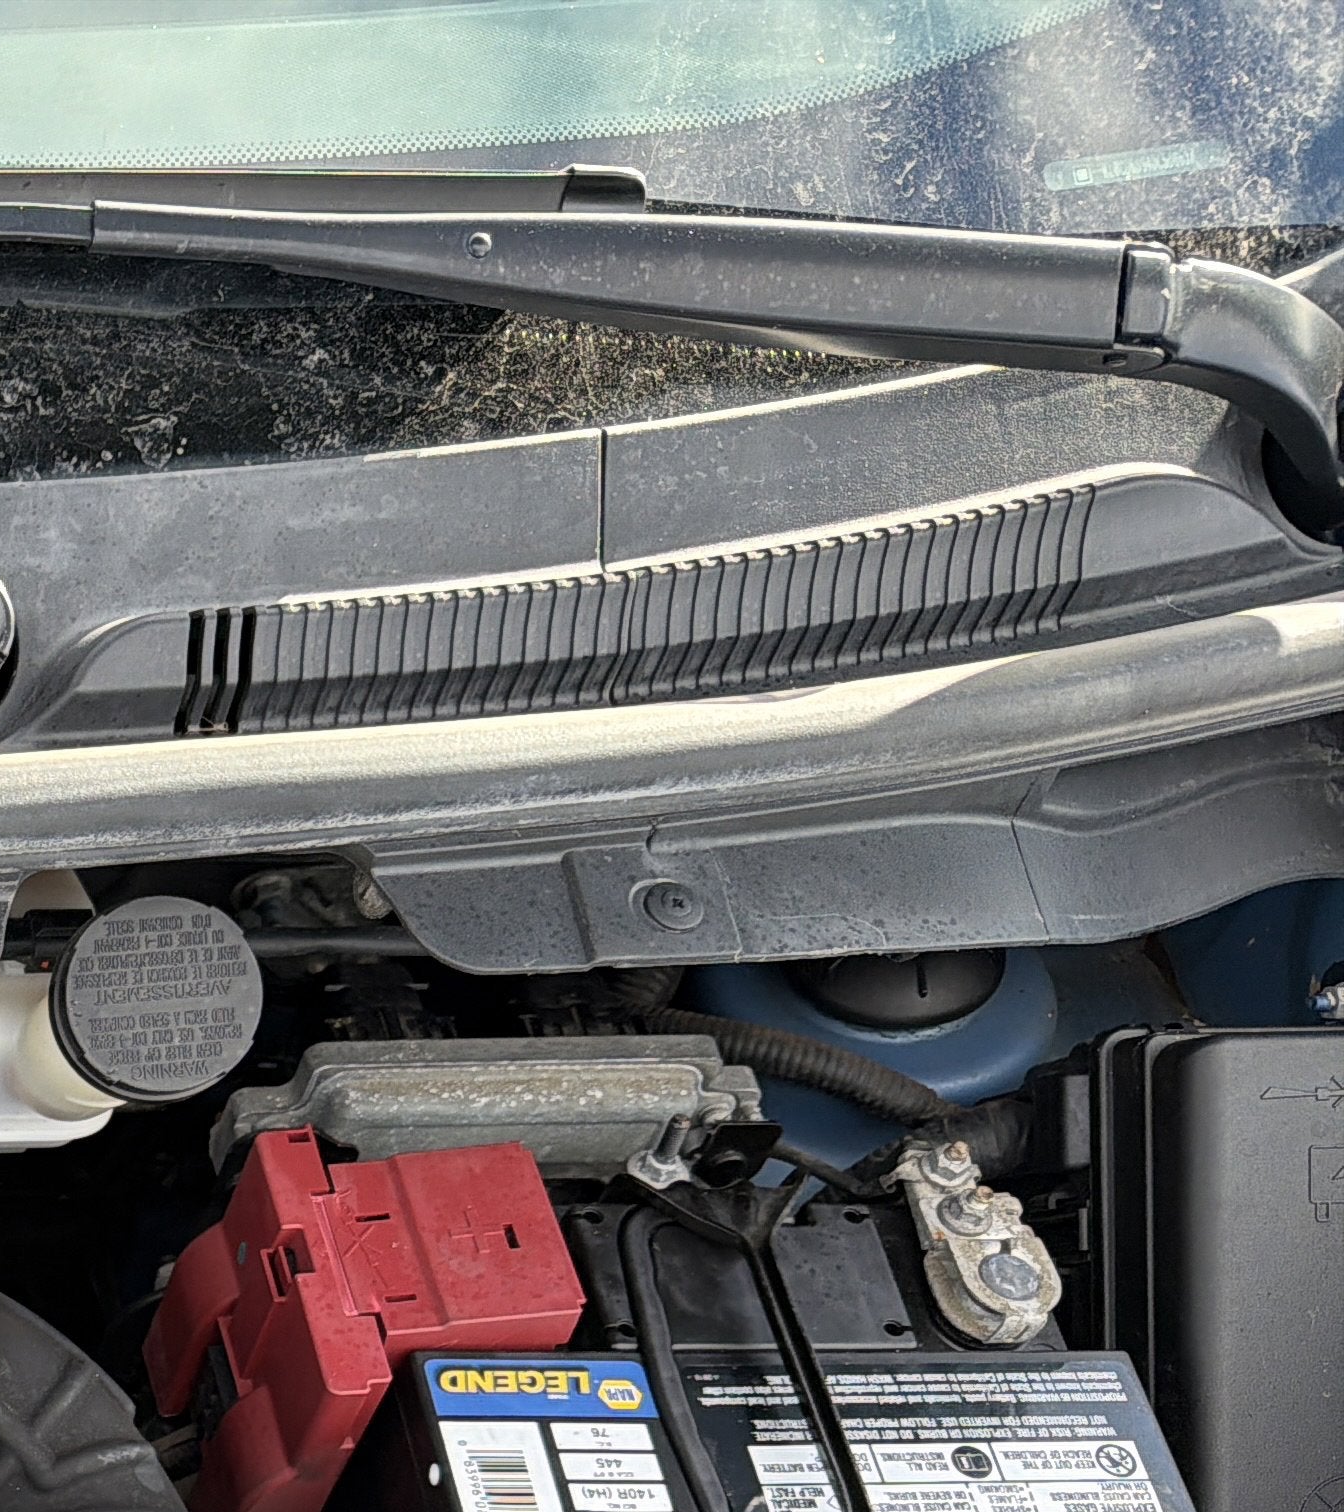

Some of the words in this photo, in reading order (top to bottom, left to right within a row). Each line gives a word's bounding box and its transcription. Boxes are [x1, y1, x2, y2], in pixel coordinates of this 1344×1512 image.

[93, 979, 232, 1005] AVERTISSEMENT
[130, 1060, 208, 1080] WARNING
[437, 1369, 590, 1395] LEGEND
[605, 1387, 636, 1401] NAPA
[590, 1428, 610, 1438] 76
[595, 1458, 623, 1468] 445
[926, 1461, 950, 1471] READ
[1021, 1461, 1037, 1470] THE
[1038, 1460, 1053, 1469] OF
[1055, 1460, 1072, 1469] OUT
[1075, 1460, 1095, 1469] KEEP
[1135, 1482, 1148, 1491] OR
[581, 1487, 612, 1499] (H4)
[617, 1488, 655, 1499] 140R
[799, 1487, 825, 1497] HELP
[1049, 1492, 1101, 1502] BLINDNESS
[1133, 1492, 1152, 1501] CAN
[769, 1499, 818, 1509] MEDICAL
[953, 1501, 971, 1511] CAN
[1100, 1502, 1156, 1512] EXPLOSIVE
